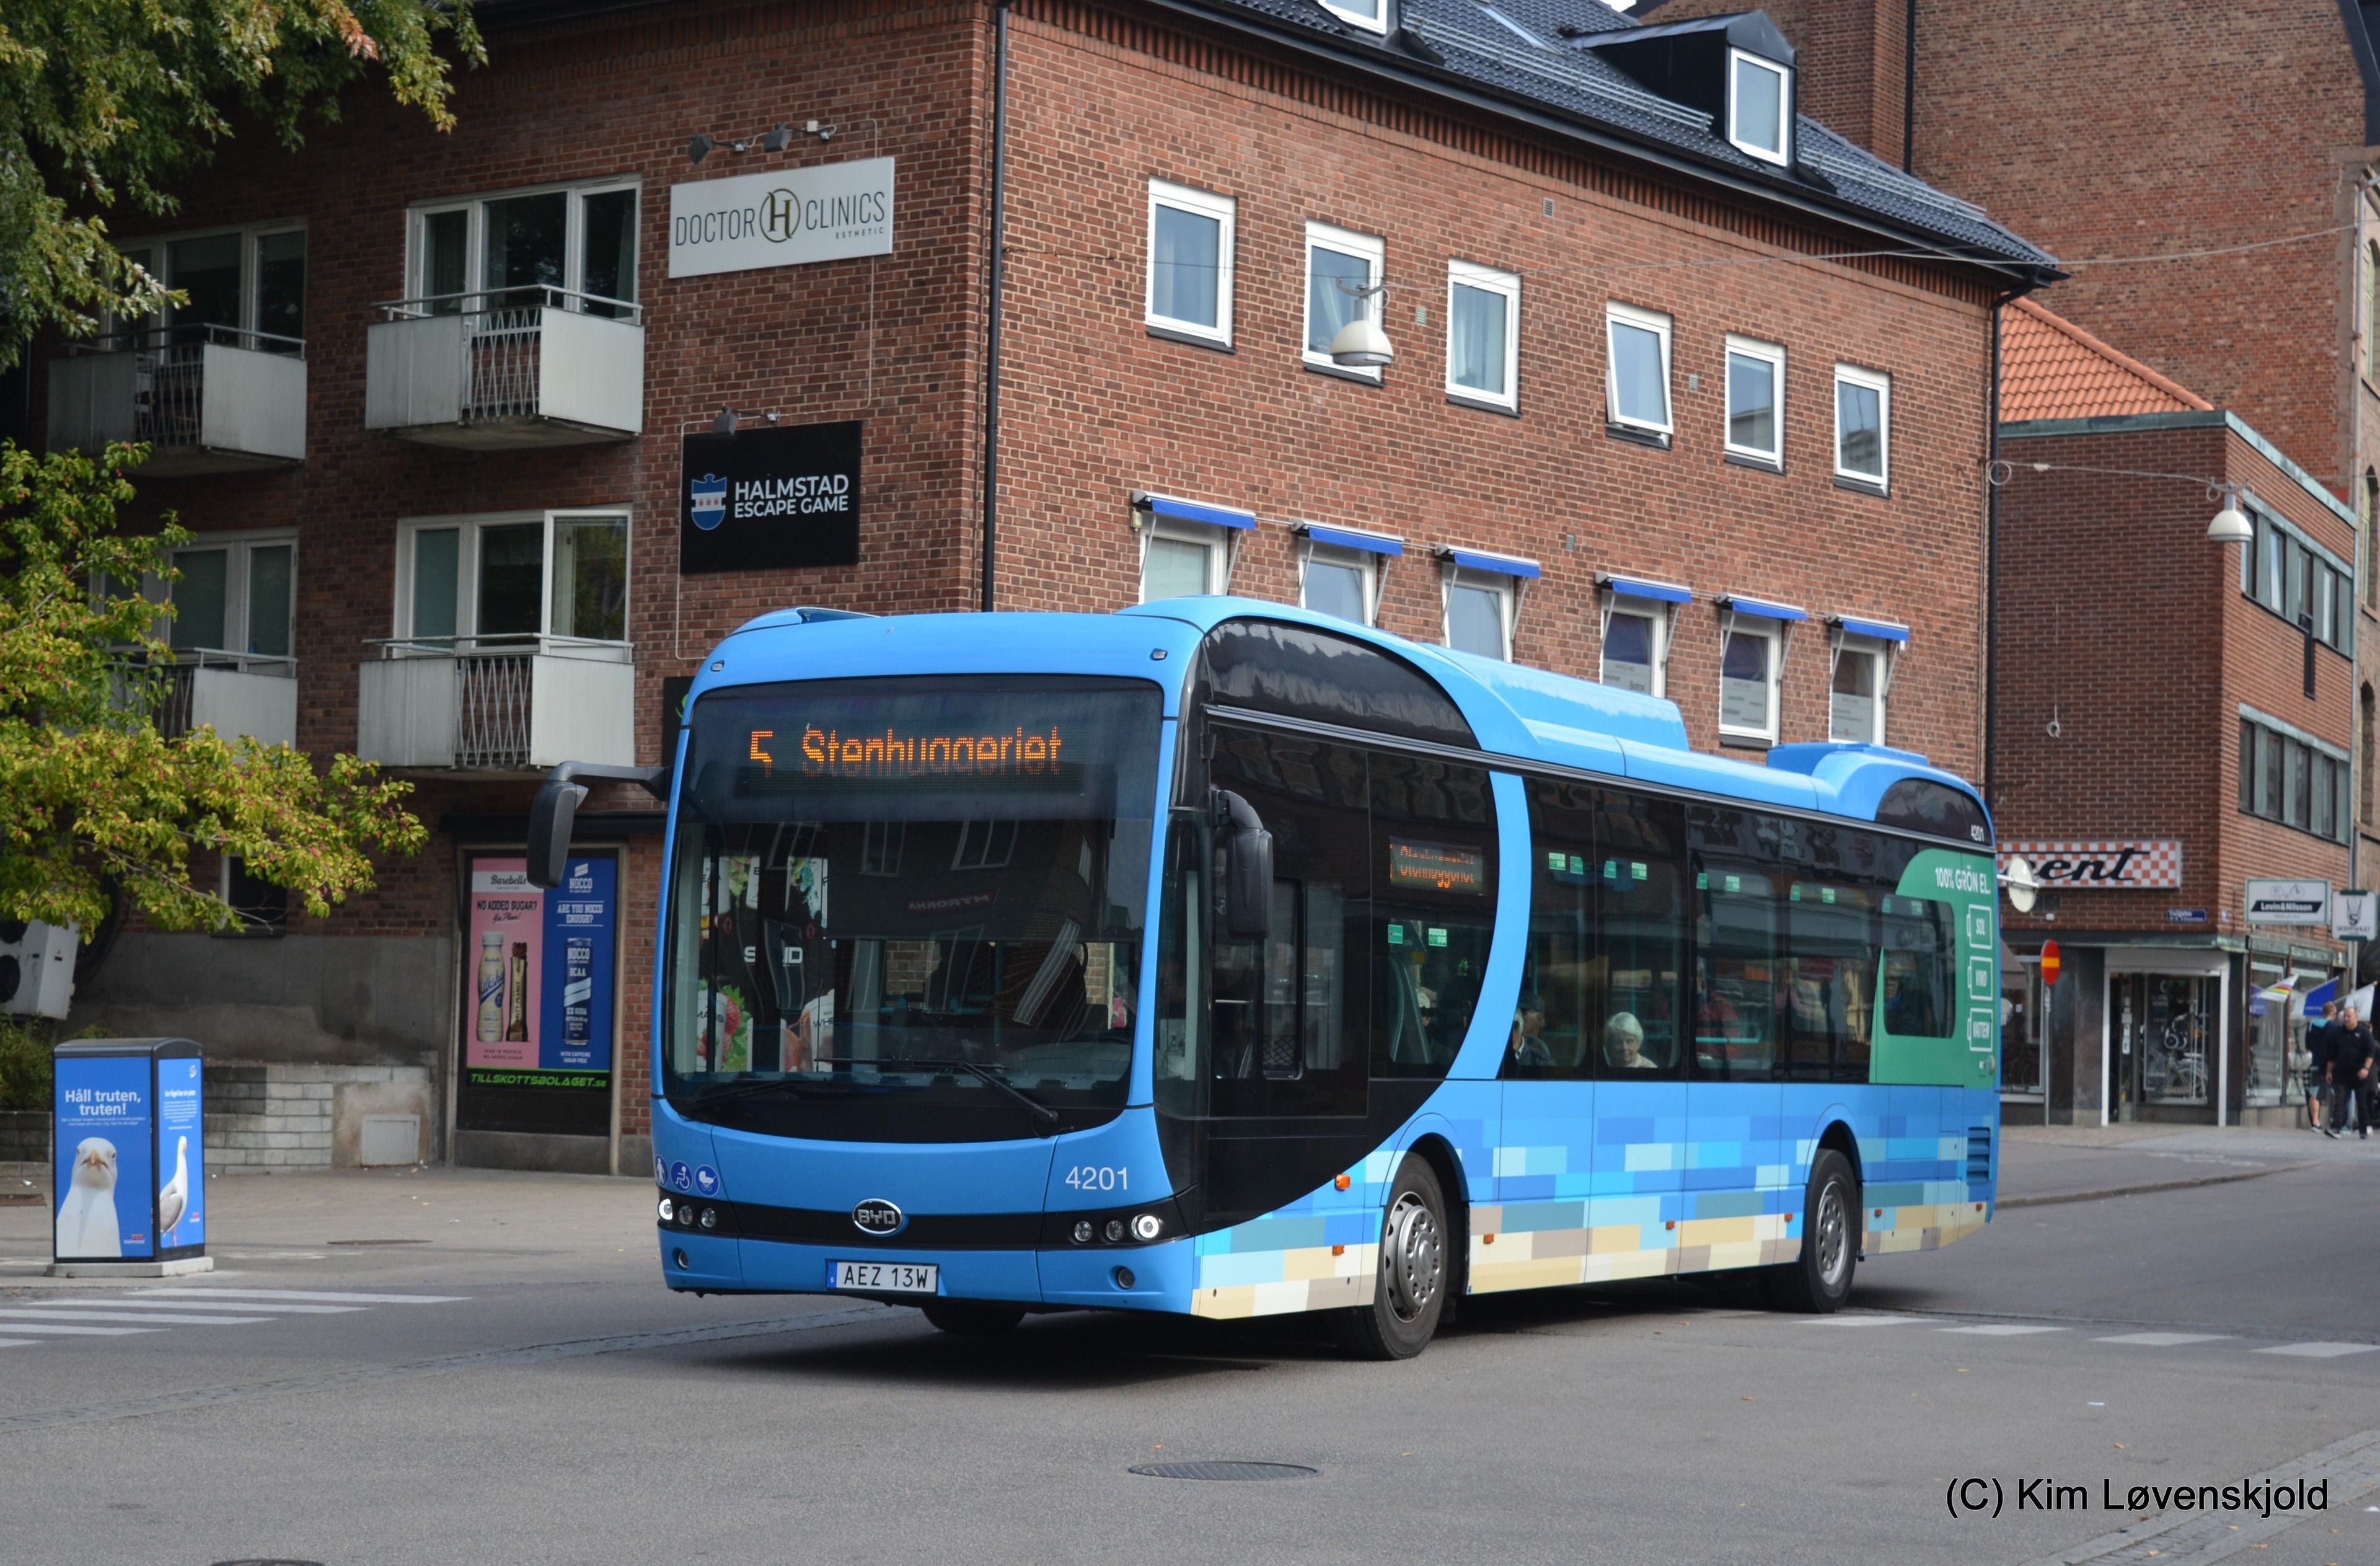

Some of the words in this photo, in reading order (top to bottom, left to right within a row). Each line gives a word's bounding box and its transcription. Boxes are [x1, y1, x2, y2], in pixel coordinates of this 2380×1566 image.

[676, 208, 755, 246] DOCTOR
[767, 192, 793, 239] H
[805, 191, 886, 231] CLINICS
[835, 226, 884, 239] ESTHETIC
[734, 474, 849, 501] HALMSTAD
[734, 498, 796, 518] ESCAPE
[800, 495, 848, 514] GAME
[1970, 824, 1985, 843] 4201
[491, 874, 527, 885] Barebells
[569, 878, 593, 889] NOCCO
[1934, 867, 1955, 889] 100%
[1955, 865, 1979, 893] GRÖN
[477, 900, 487, 911] NO
[487, 900, 509, 911] ADDED
[511, 900, 538, 911] SUGAR?
[65, 1088, 92, 1102] Håll
[94, 1090, 142, 1104] truten,
[79, 1103, 126, 1115] truten!
[1065, 1166, 1127, 1190] 4201
[857, 1209, 896, 1225] BYD
[844, 1265, 881, 1286] AEZ
[891, 1267, 928, 1288] 13W
